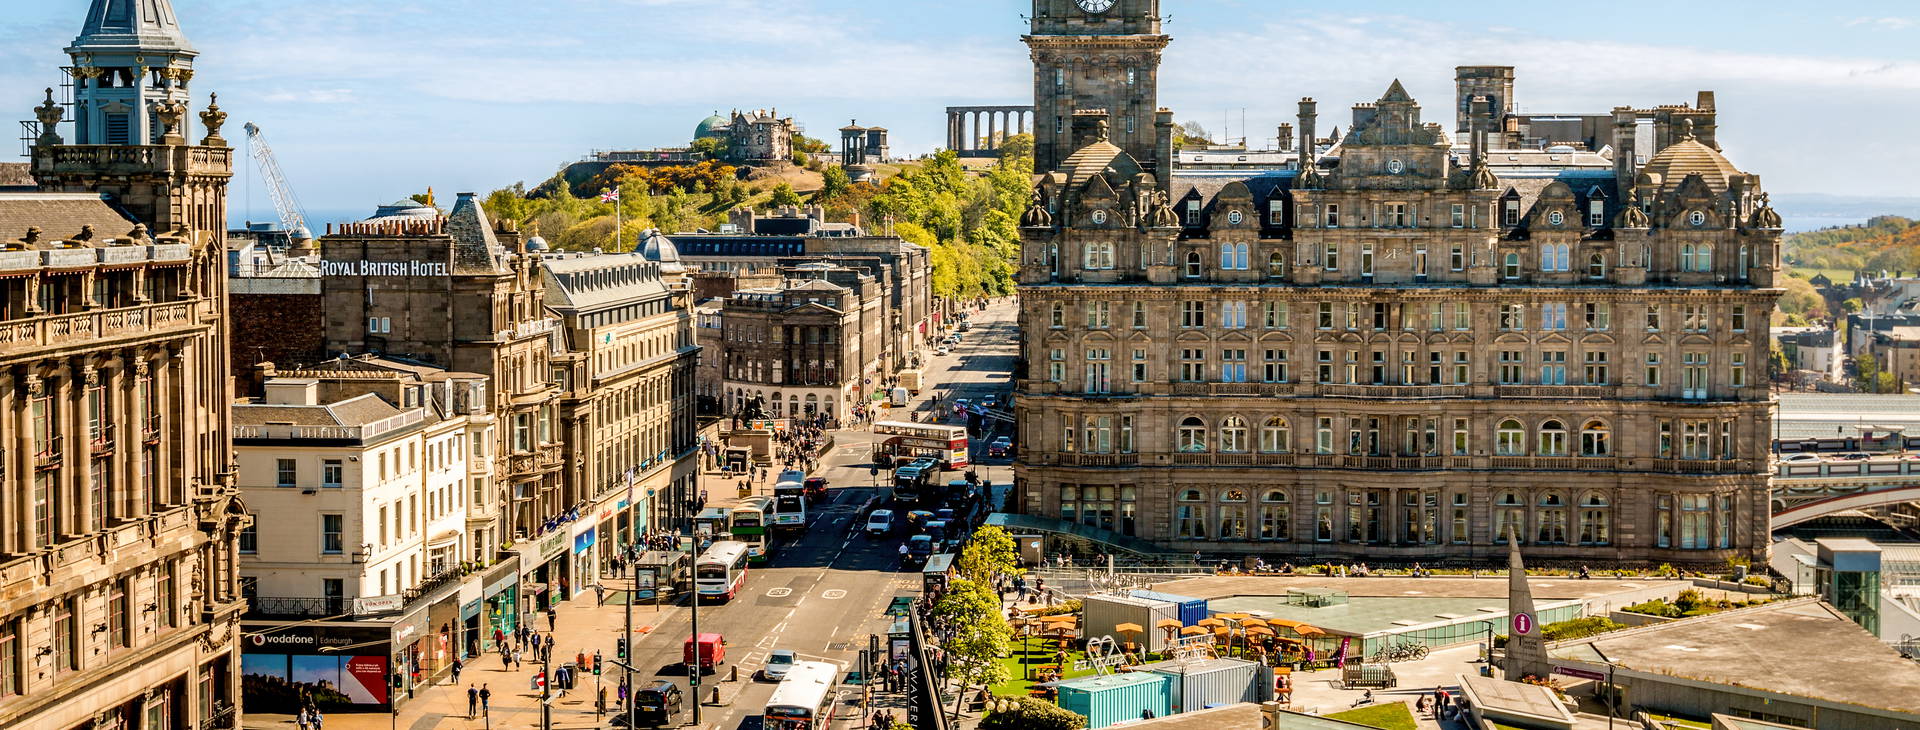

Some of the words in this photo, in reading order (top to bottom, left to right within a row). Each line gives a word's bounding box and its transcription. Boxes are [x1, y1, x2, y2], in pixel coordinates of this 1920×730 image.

[320, 260, 358, 276] ROYAL
[360, 260, 407, 276] BRITISH
[411, 260, 449, 276] HOTEL
[267, 634, 314, 644] vodafone
[320, 636, 353, 646] Edinburgh
